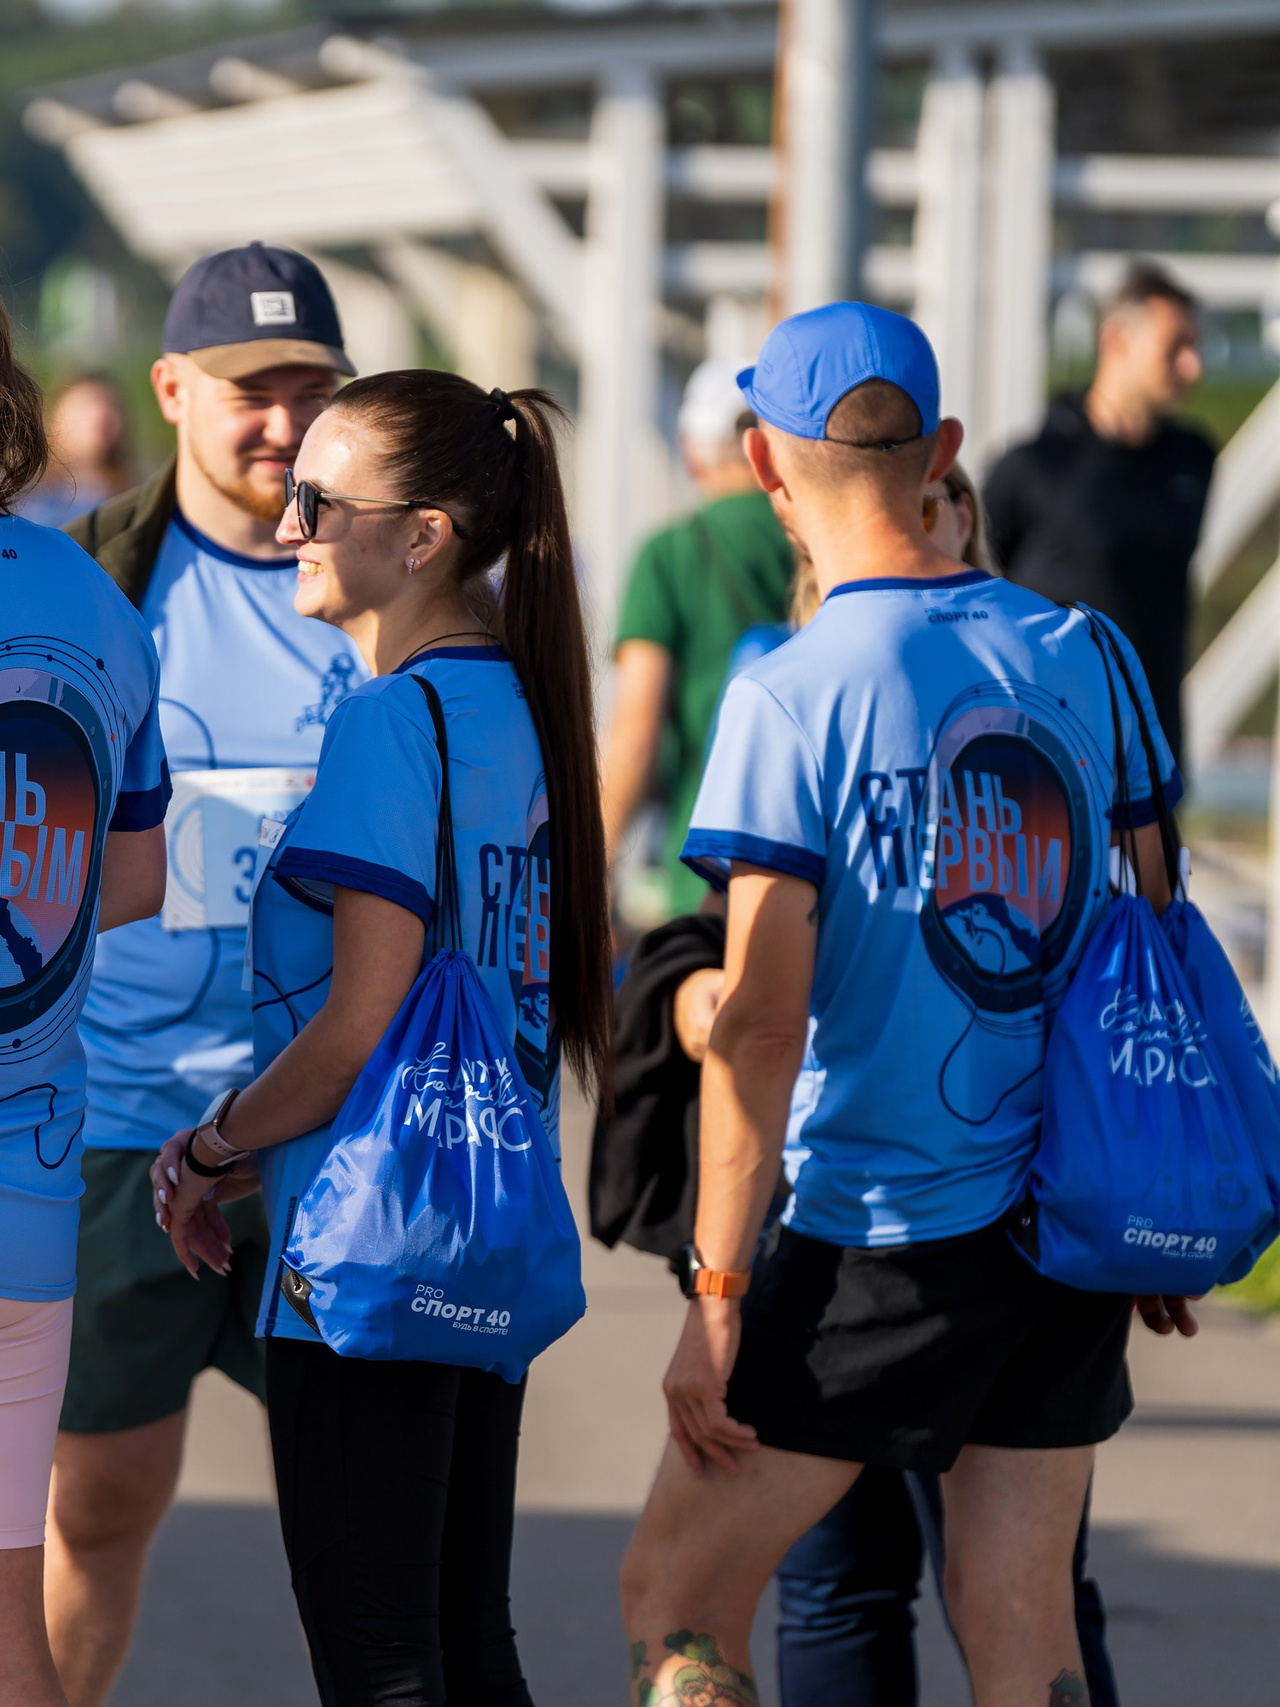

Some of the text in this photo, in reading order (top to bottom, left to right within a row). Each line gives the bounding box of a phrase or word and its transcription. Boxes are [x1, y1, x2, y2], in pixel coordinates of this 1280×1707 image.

[1, 548, 18, 560] 40
[928, 610, 989, 625] СПОРТ 40
[858, 766, 1022, 836] СТАНЬ
[1127, 1214, 1154, 1228] PRO
[1124, 1227, 1218, 1252] СПОРТ 40
[415, 1284, 445, 1299] PRO
[411, 1297, 511, 1327] СПОРТ 40
[452, 1321, 472, 1331] БУДЬ
[479, 1326, 509, 1336] СПОРТЕ!
